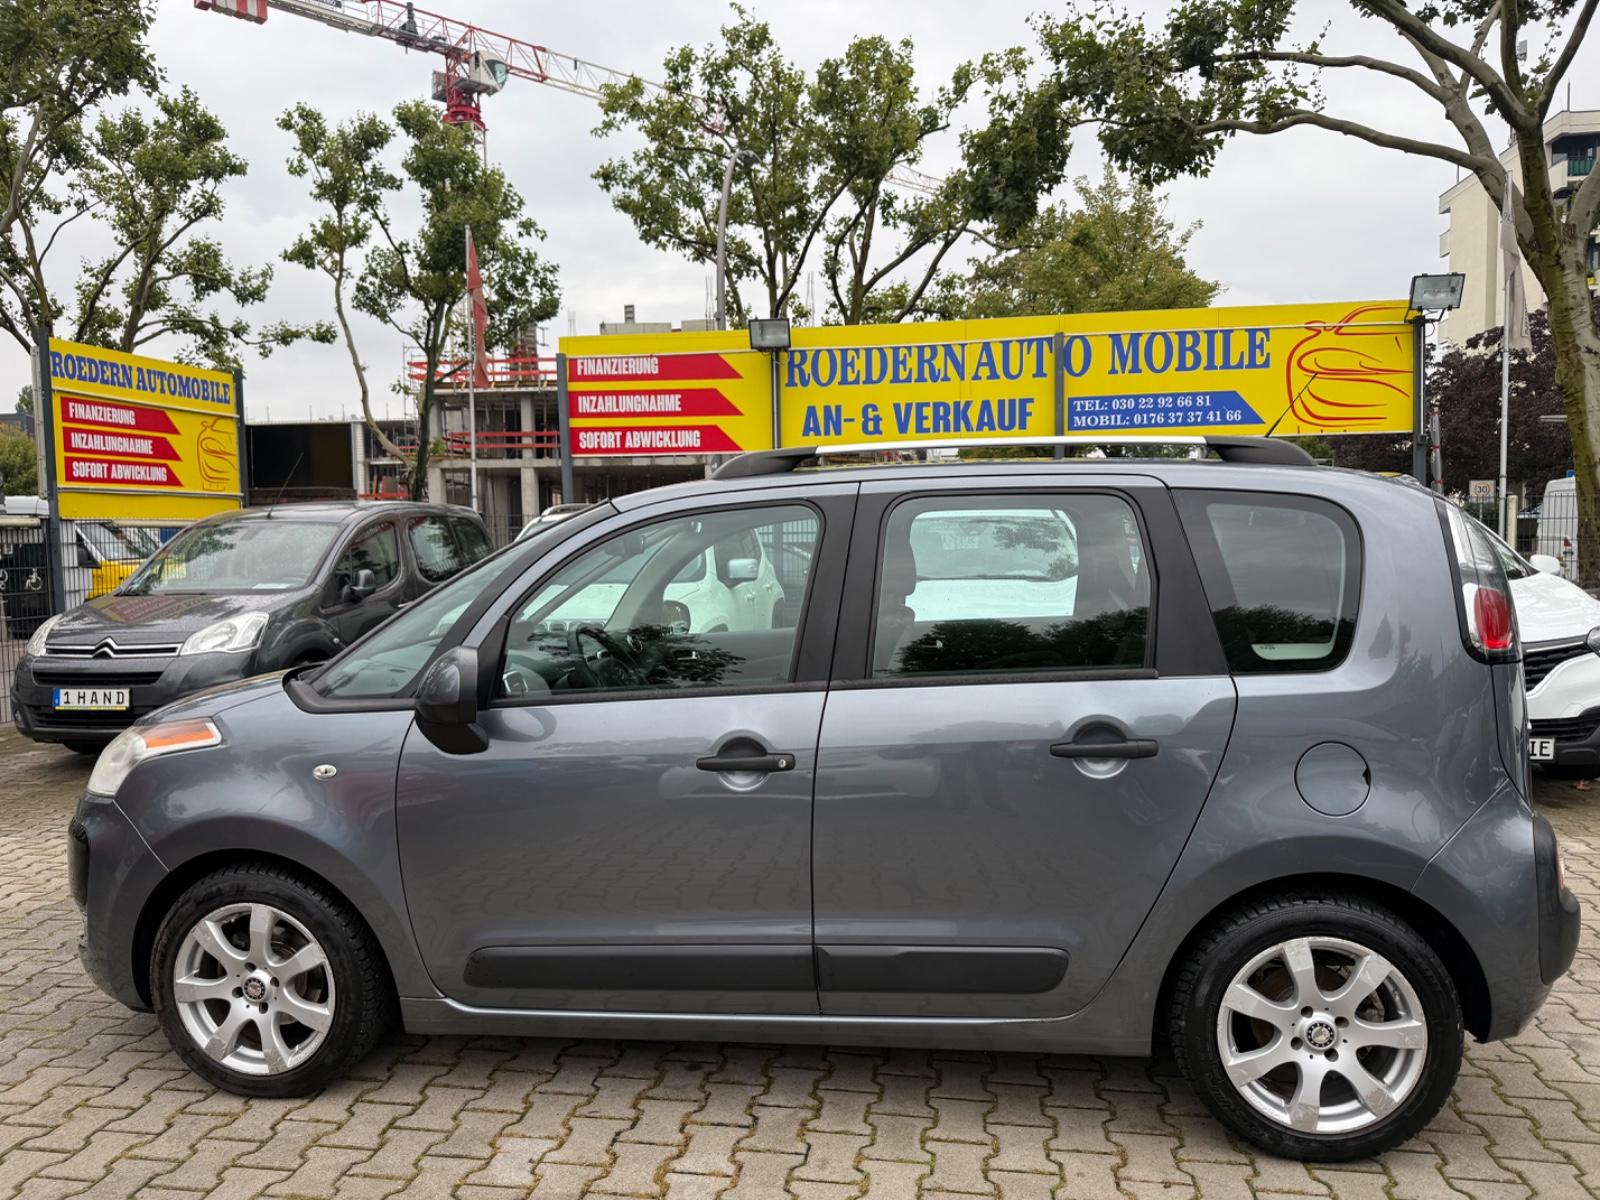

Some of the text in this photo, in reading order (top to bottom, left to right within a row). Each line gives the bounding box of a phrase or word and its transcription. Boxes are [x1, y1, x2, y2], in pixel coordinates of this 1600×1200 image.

[577, 357, 659, 376] FINANZIERUNG
[785, 343, 966, 387] ROEDERN
[51, 351, 230, 404] ROEDERN AUTOMOBILE
[578, 394, 681, 413] INZAHLUNGNAHME
[1073, 395, 1211, 412] TEL: 030 22 92 66 81
[69, 402, 136, 426] FINANZIERUNG
[802, 398, 1035, 437] AN- & VERKAUF
[1073, 409, 1242, 427] MOBIL: 0176 37 37 41 66
[71, 432, 153, 455] INZAHLUNGNAHME
[579, 430, 701, 449] SOFORT ABWICKLUNG
[72, 462, 168, 482] SOFORT ABWICKLUNG
[1476, 485, 1488, 493] 30
